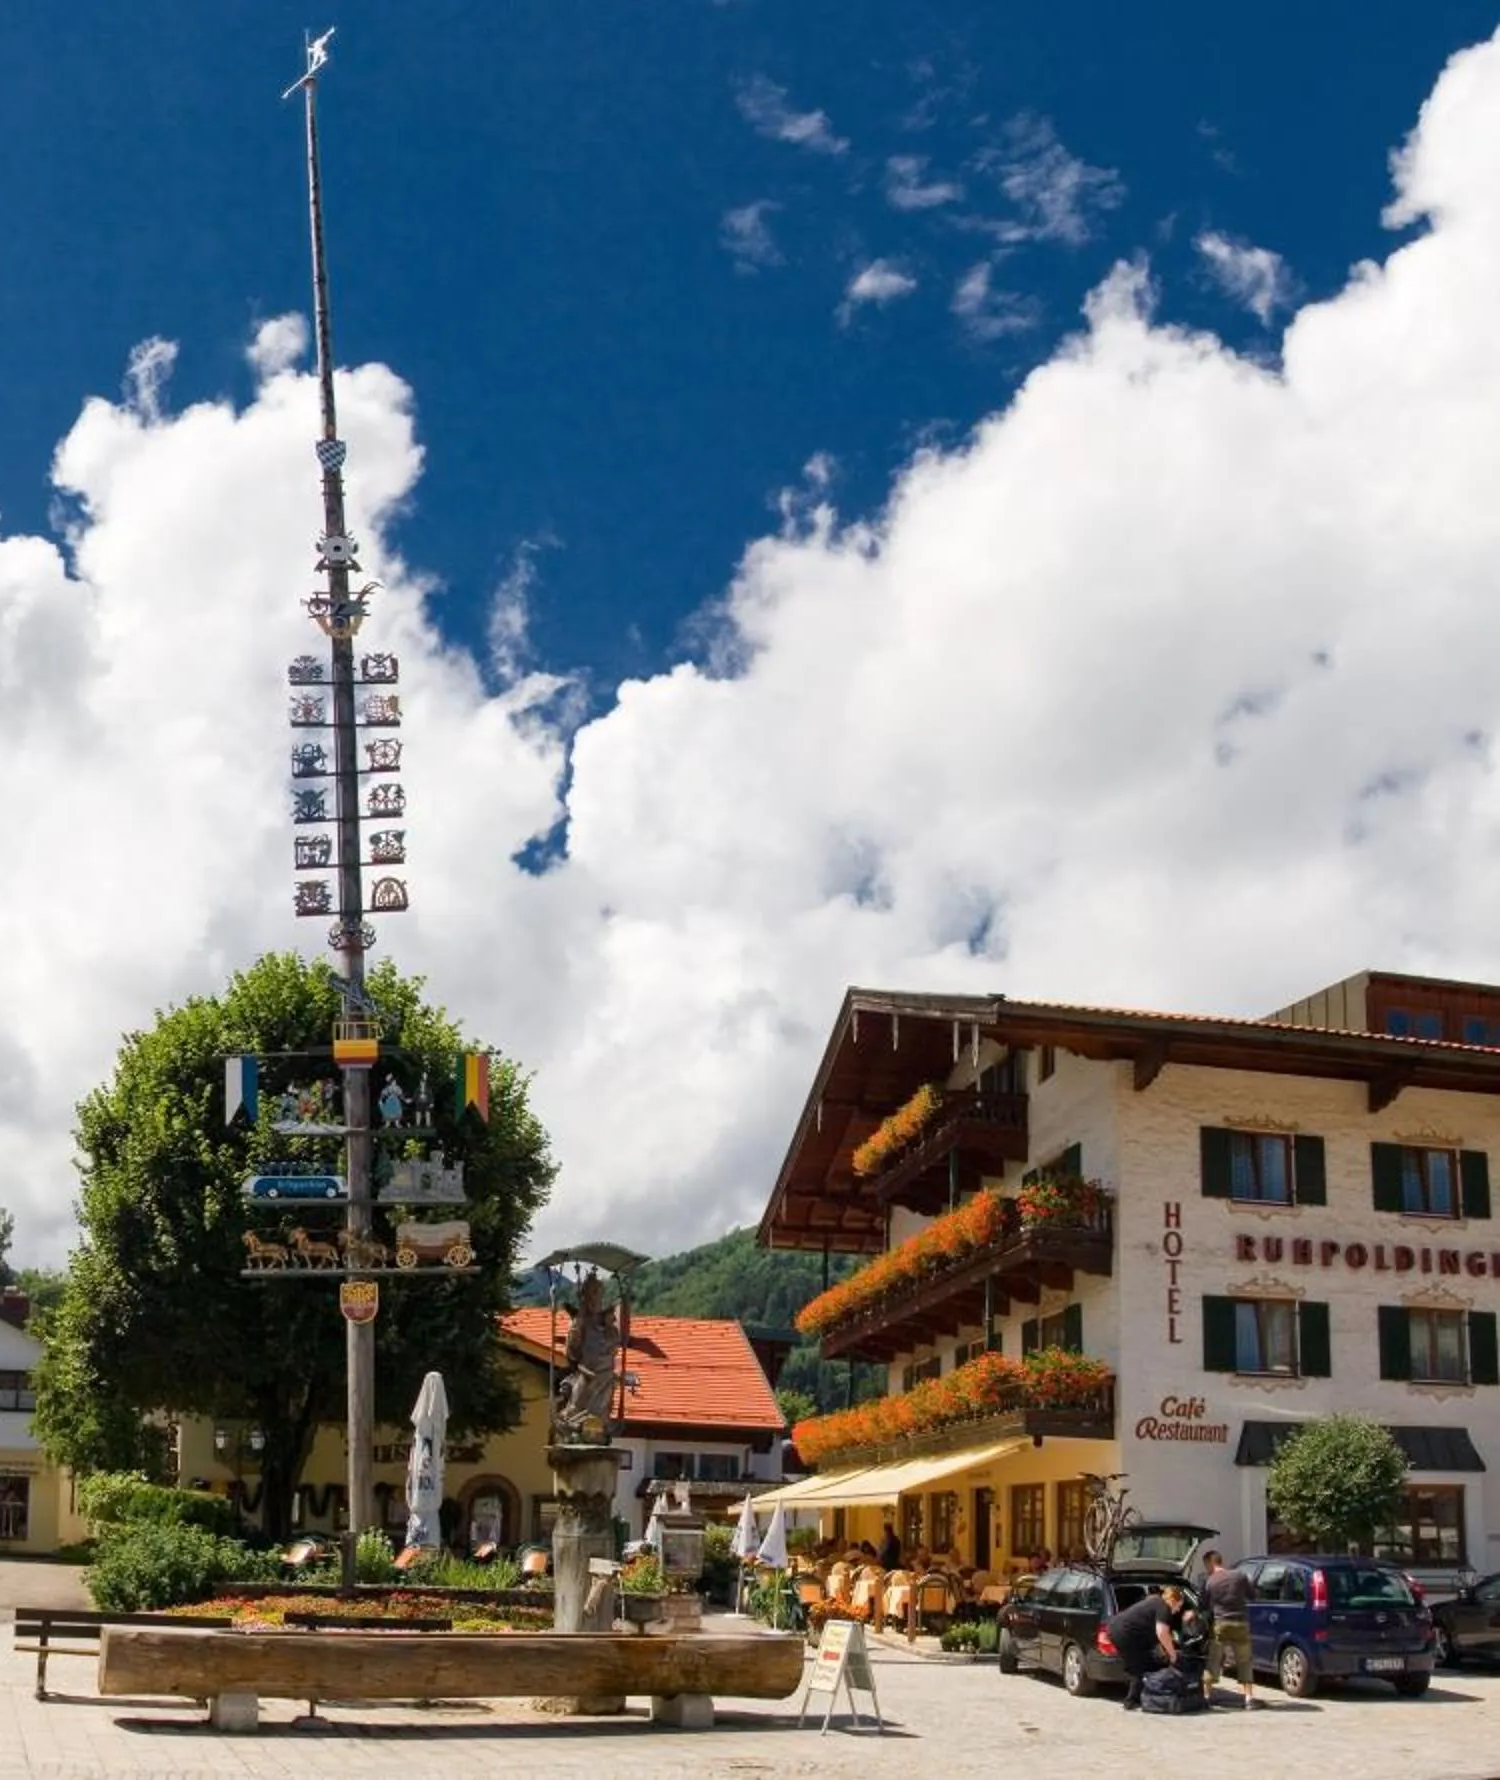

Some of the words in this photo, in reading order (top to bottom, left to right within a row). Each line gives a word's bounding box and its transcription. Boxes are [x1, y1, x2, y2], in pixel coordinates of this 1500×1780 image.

[1163, 1202, 1183, 1344] HOTEL
[1160, 1395, 1205, 1420] Café
[1135, 1416, 1228, 1443] Restaurant
